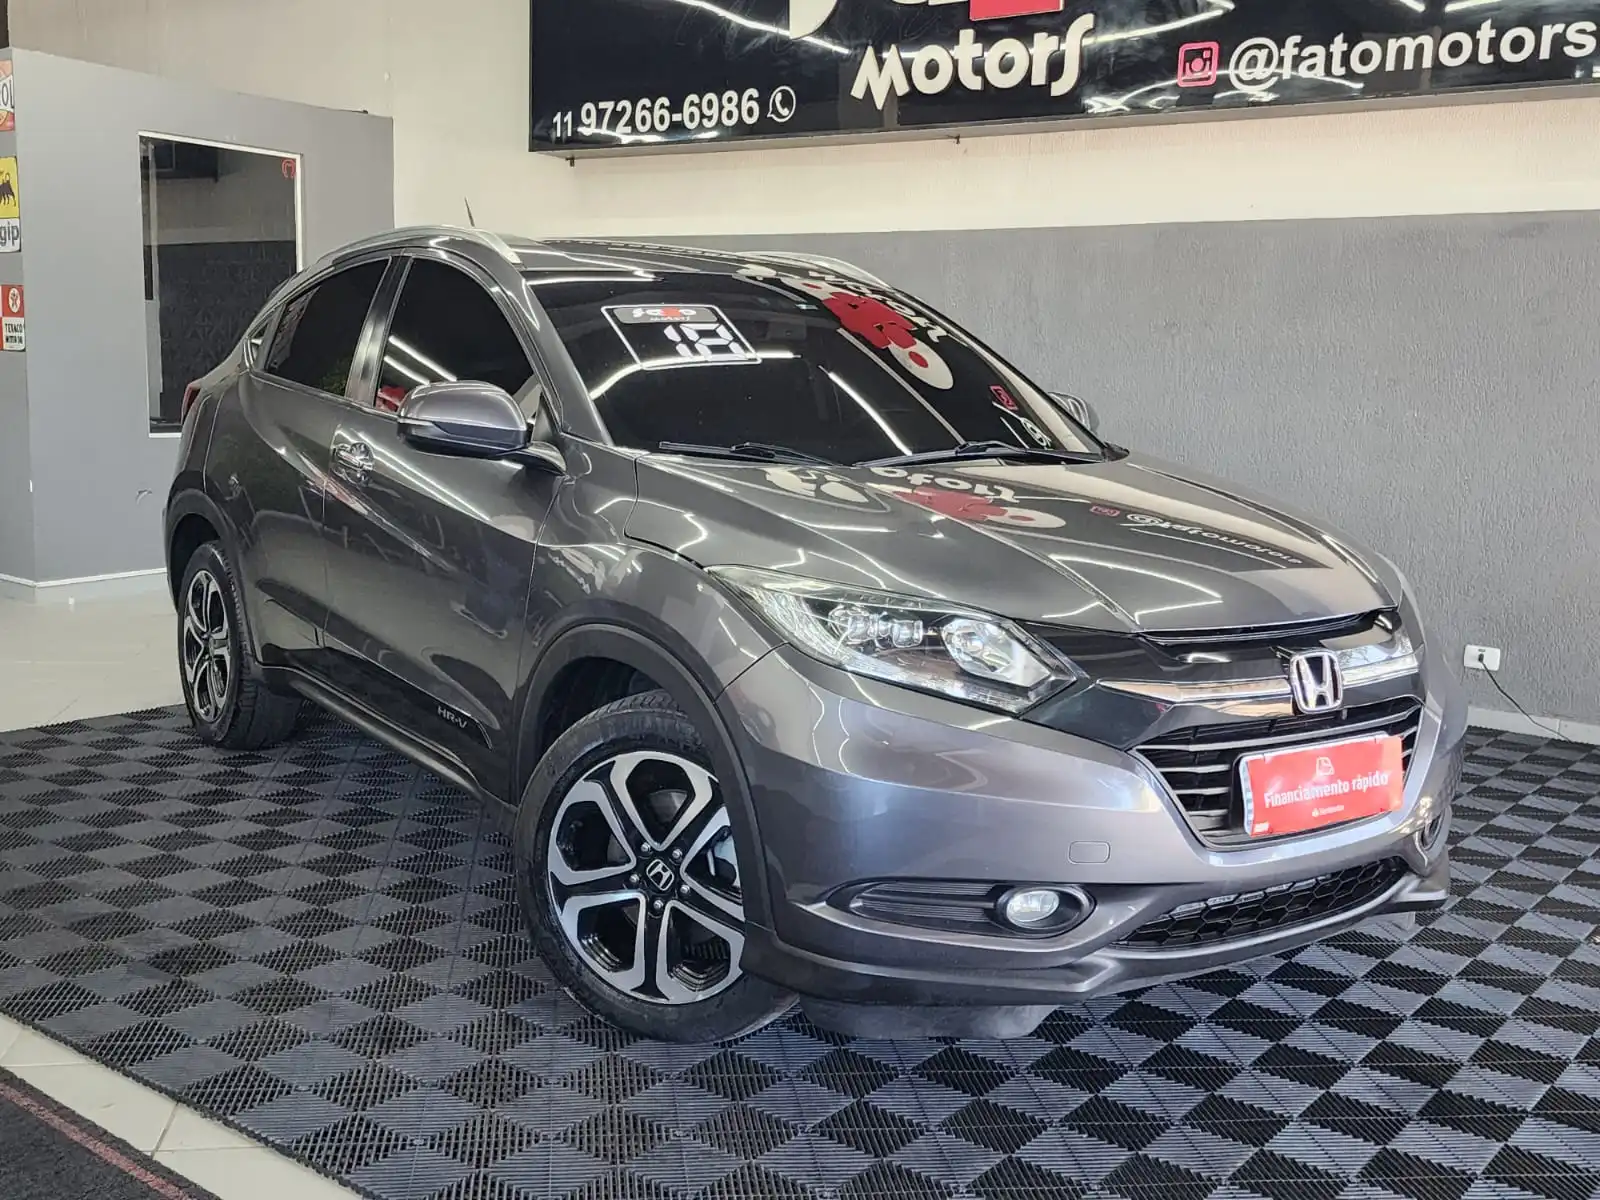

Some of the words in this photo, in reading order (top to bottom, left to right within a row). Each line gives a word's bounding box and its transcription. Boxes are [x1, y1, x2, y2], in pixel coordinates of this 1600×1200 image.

[1229, 19, 1598, 91] @fatomotors
[552, 111, 573, 137] 11
[580, 87, 760, 136] 97266-6986
[437, 705, 468, 728] HR-V
[1263, 779, 1350, 808] Financiamento
[1352, 770, 1389, 793] rápido
